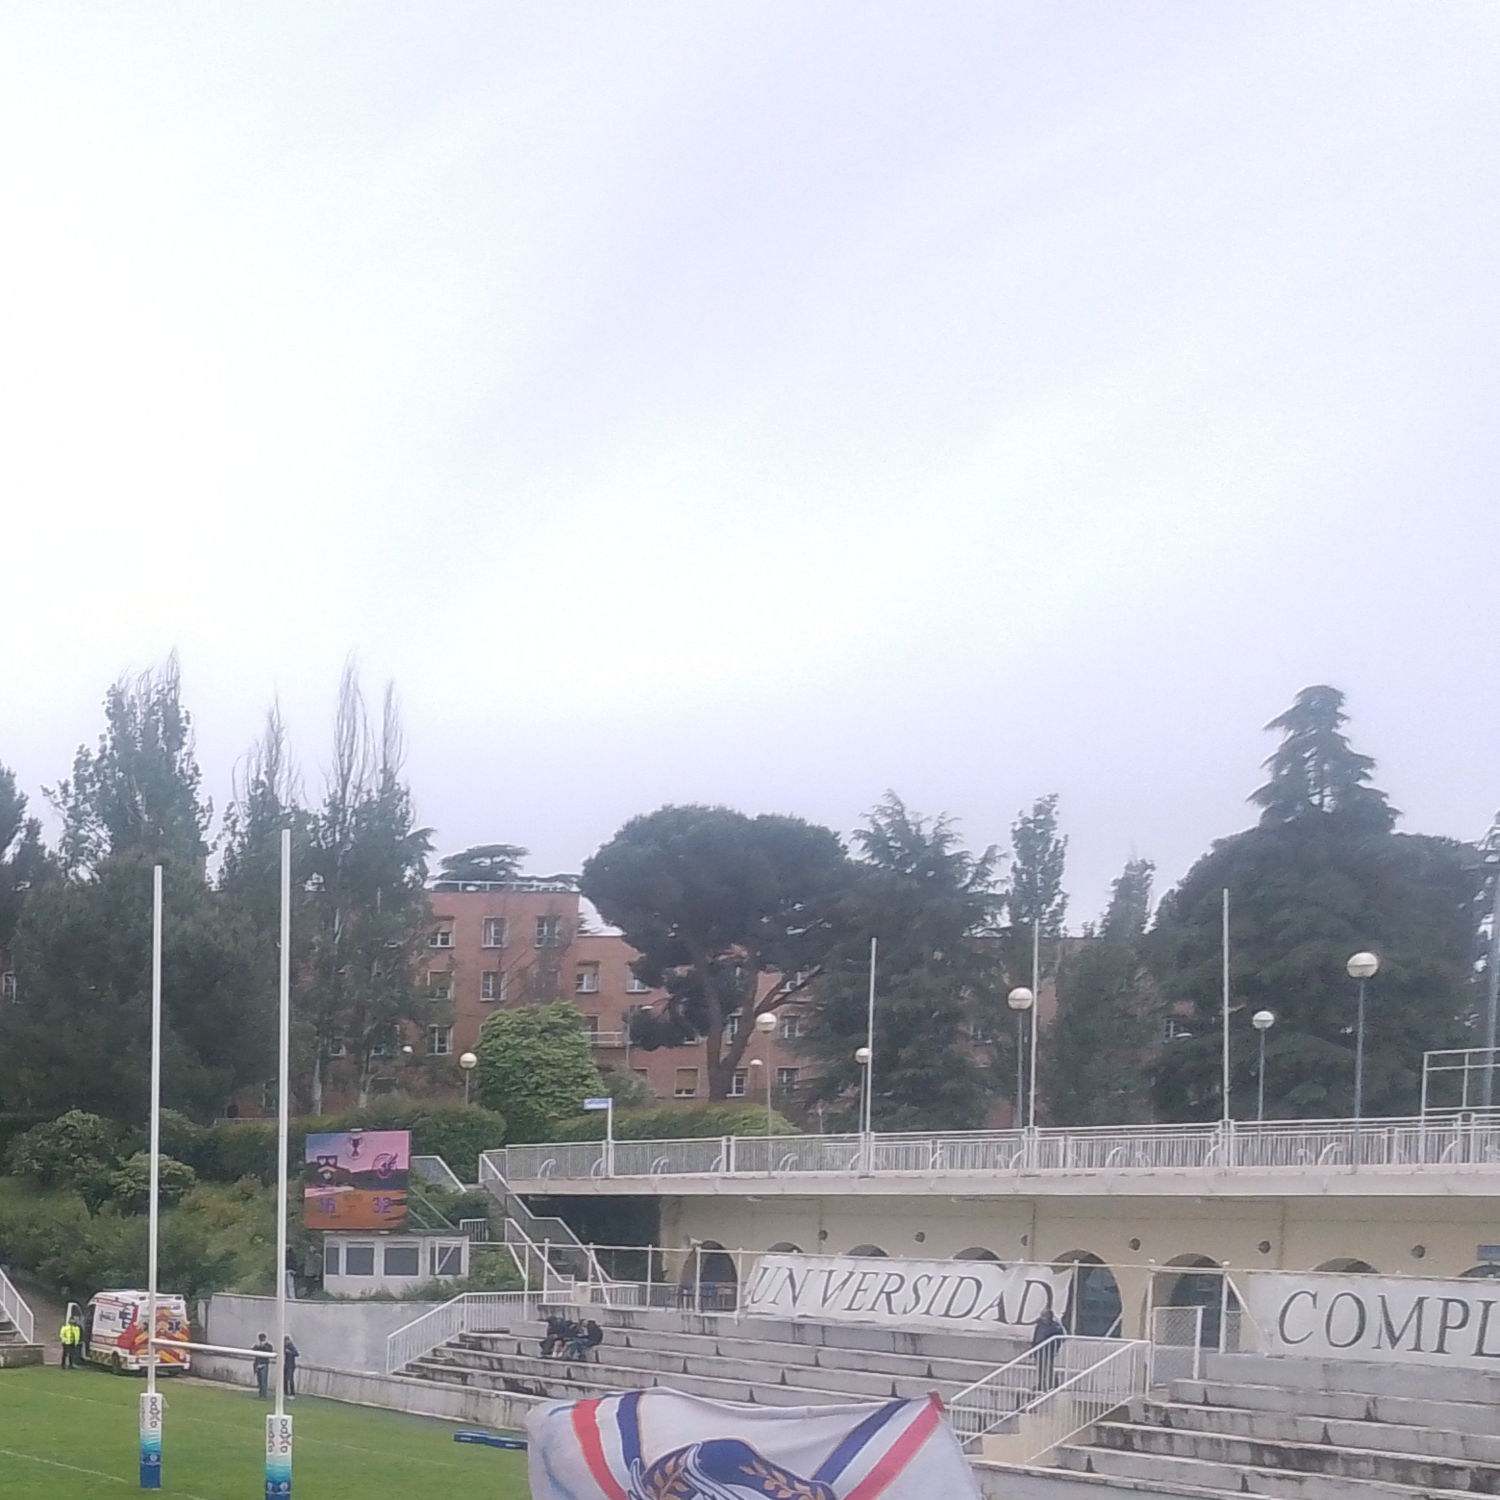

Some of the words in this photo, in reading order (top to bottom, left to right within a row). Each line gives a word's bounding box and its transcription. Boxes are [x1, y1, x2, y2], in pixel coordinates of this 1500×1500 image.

[372, 1196, 392, 1214] 32
[1278, 1289, 1500, 1358] COMPL
[280, 1418, 292, 1453] axpo
